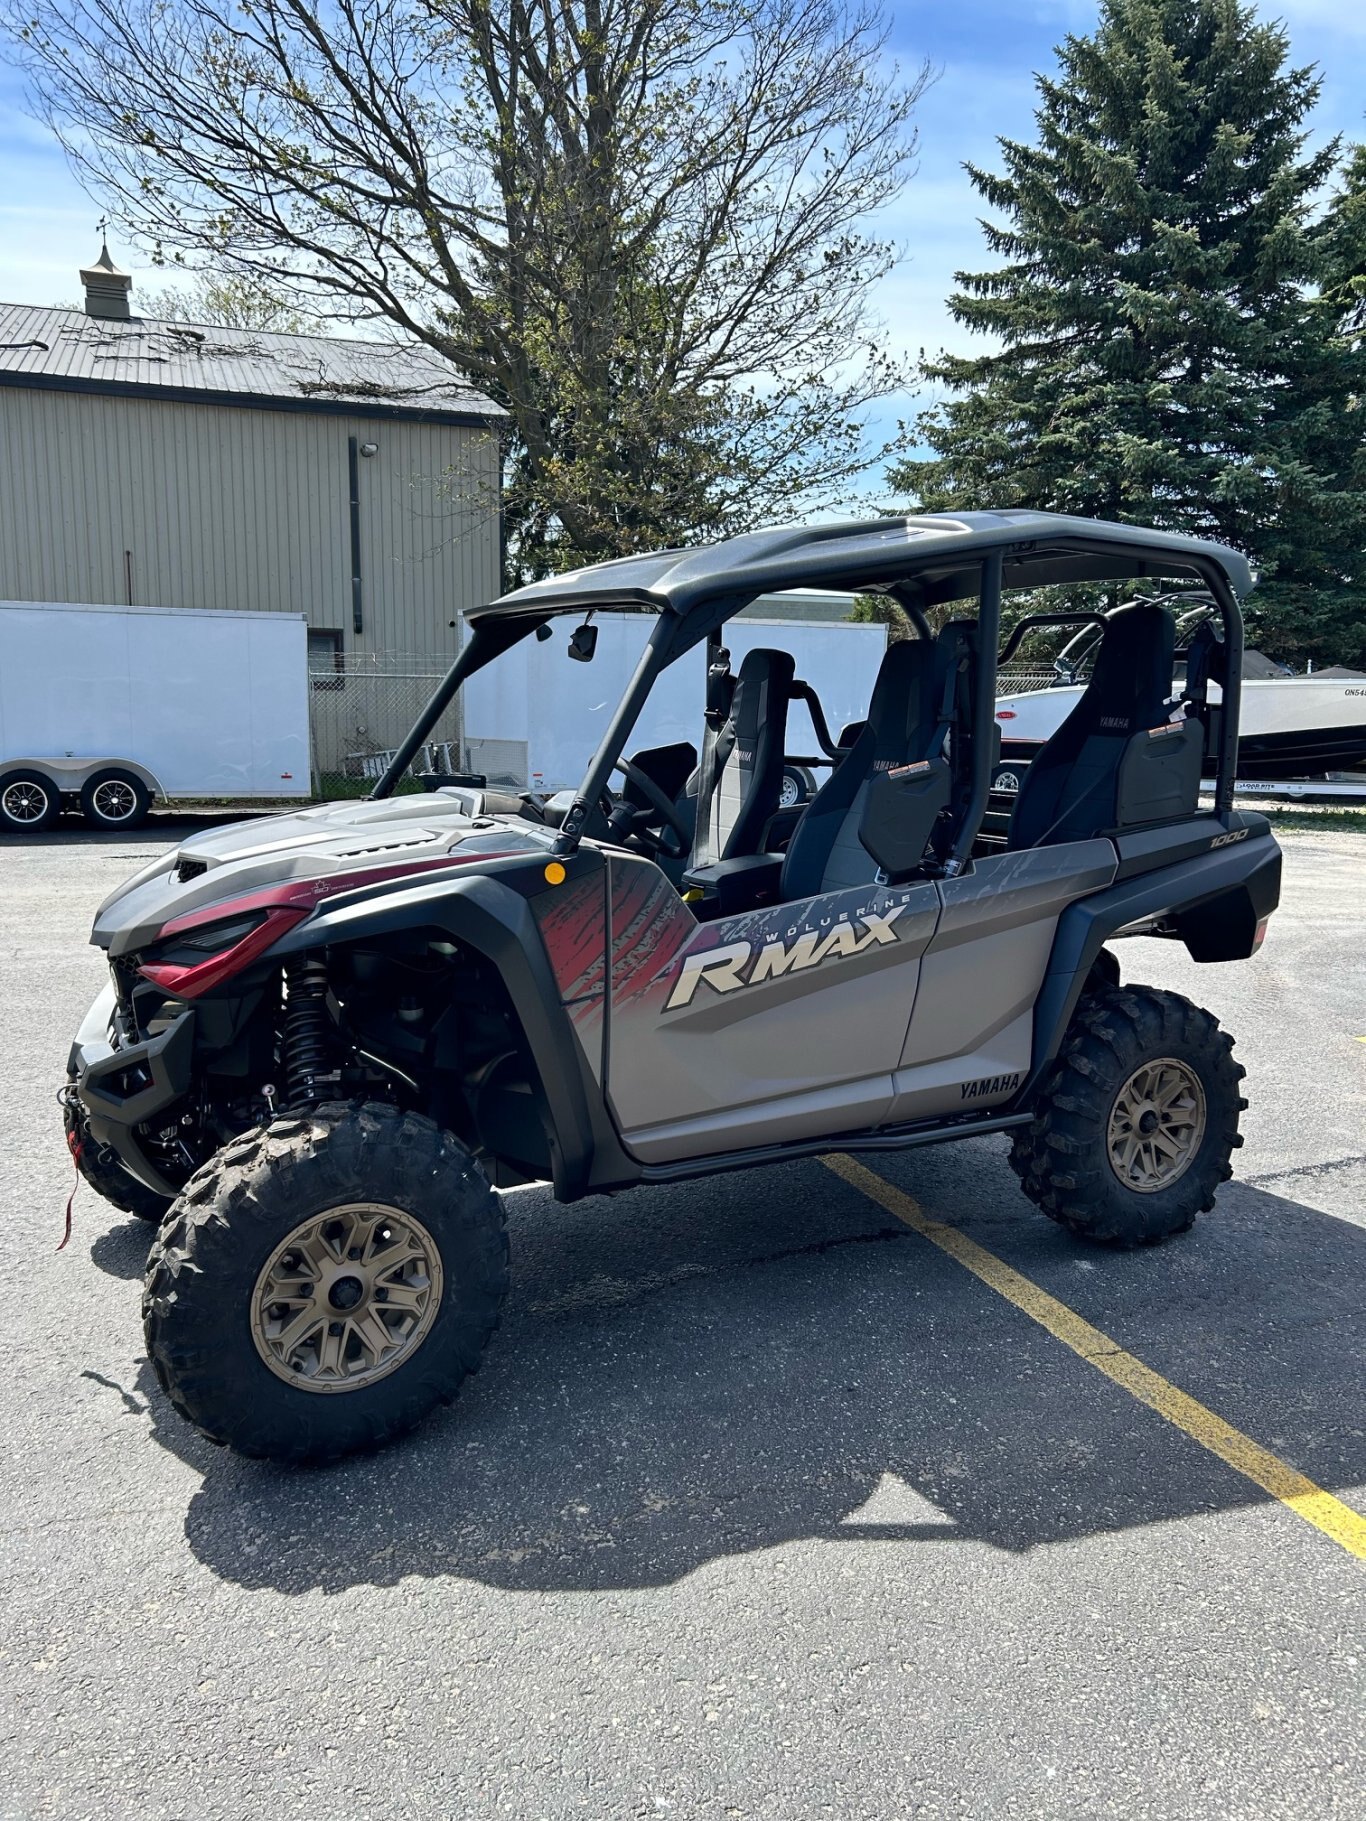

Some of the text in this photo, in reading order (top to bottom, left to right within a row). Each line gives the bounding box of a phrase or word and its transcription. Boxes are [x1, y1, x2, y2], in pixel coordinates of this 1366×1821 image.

[1100, 716, 1129, 729] YAMAHA
[1210, 828, 1249, 849] 1000
[765, 894, 911, 943] WOLVERINE
[662, 904, 907, 1012] RMAX
[961, 1073, 1020, 1100] YAMAHA
